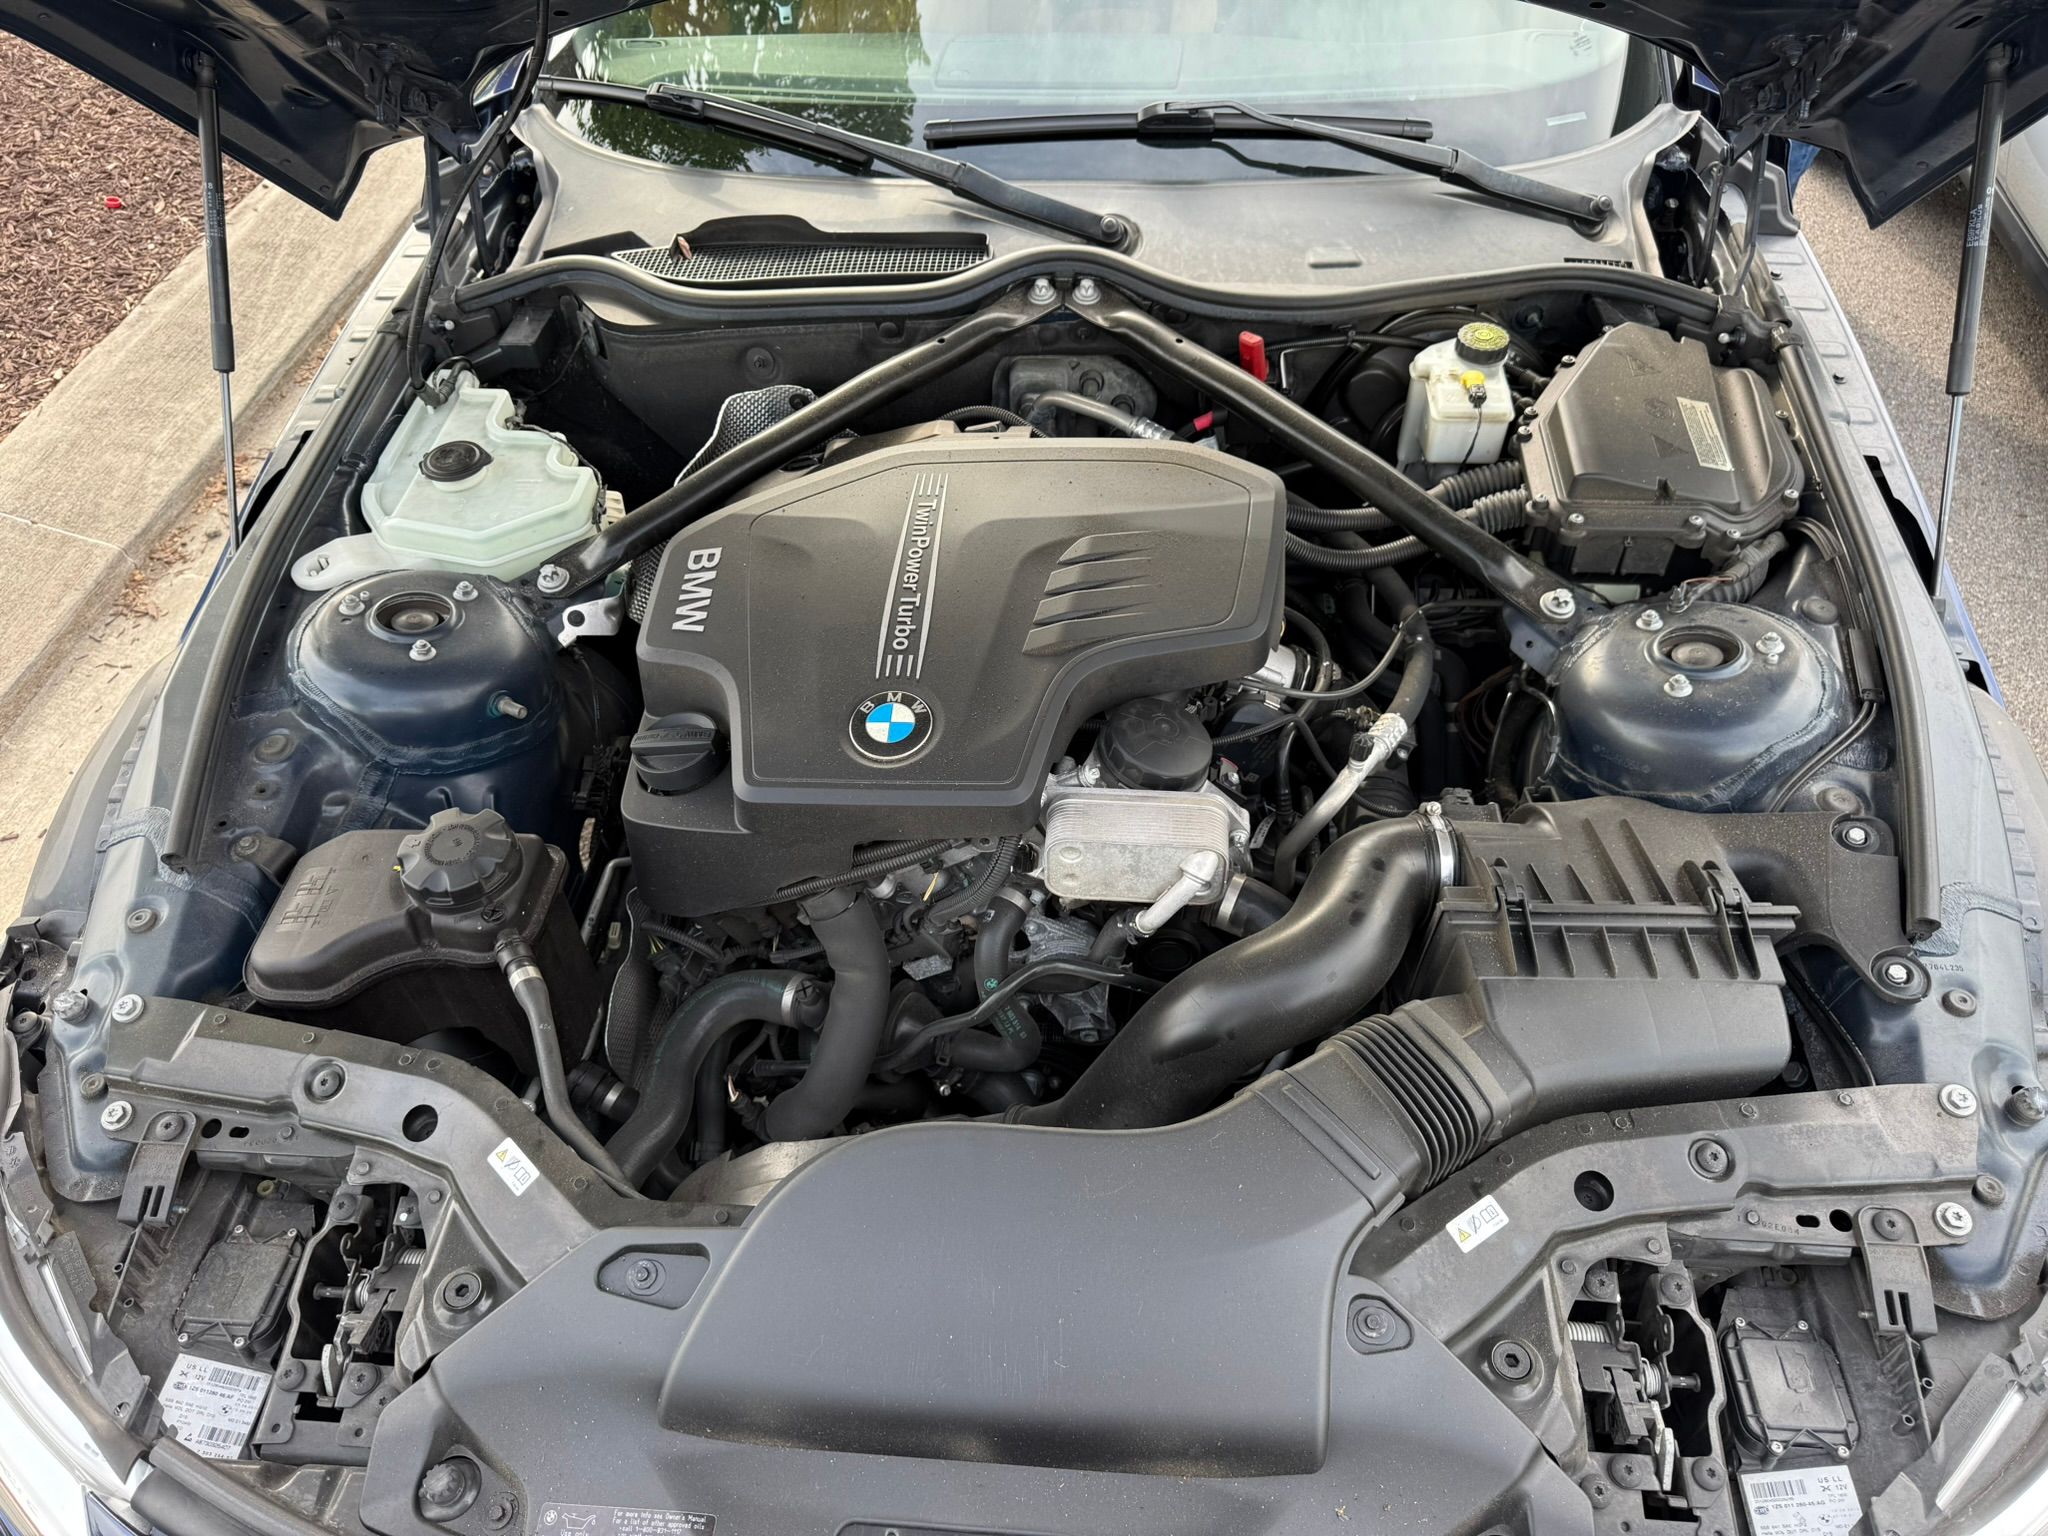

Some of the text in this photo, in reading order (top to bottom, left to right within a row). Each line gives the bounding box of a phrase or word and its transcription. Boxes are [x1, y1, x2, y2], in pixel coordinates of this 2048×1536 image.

[892, 499, 938, 650] TwinPower Turbo
[672, 547, 722, 632] BMW
[860, 692, 927, 714] BMW
[1818, 1476, 1830, 1484] US
[612, 1516, 622, 1525] For
[630, 1518, 640, 1526] list
[667, 1521, 692, 1529] approved
[614, 1509, 624, 1517] For
[665, 1512, 686, 1520] Owner's
[688, 1514, 707, 1522] Manual
